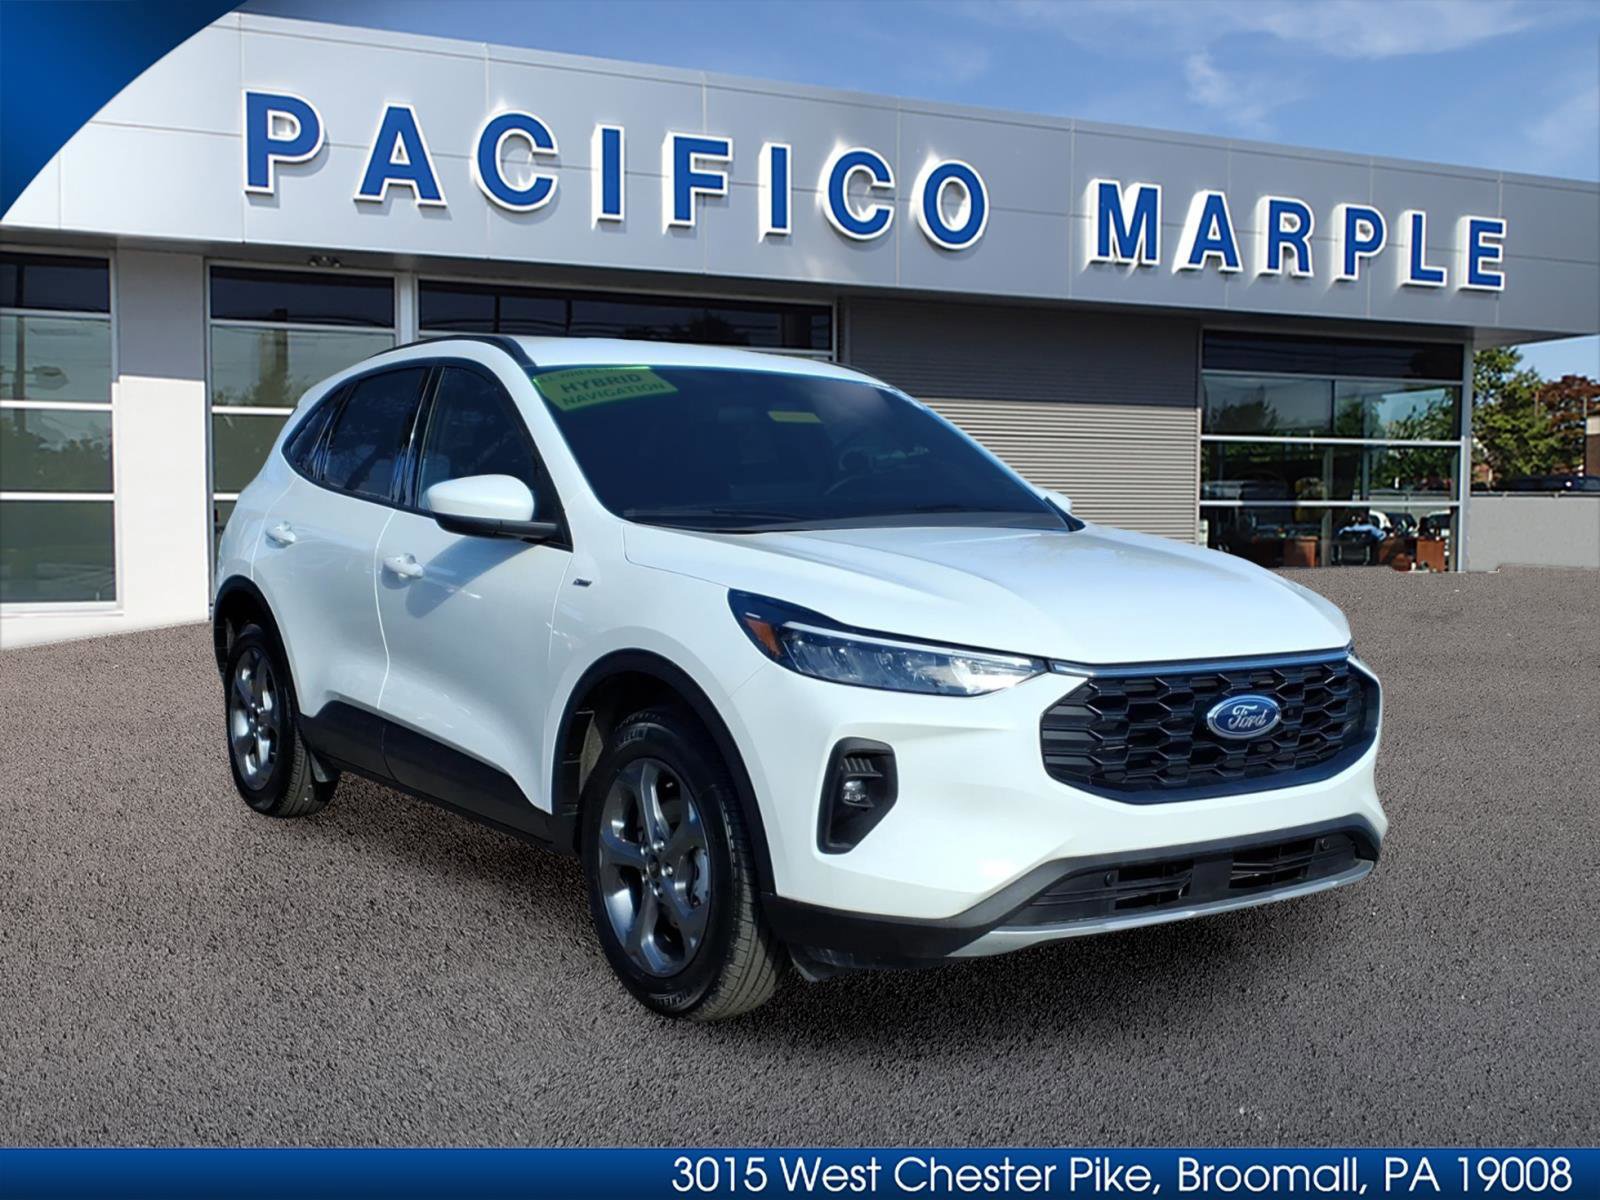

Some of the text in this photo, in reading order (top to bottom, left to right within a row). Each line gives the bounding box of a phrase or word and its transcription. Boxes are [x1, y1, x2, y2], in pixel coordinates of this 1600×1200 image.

[242, 88, 1507, 292] PACIFICO MARPLE
[561, 373, 643, 394] HYBRID
[562, 382, 666, 406] NAVIGATION
[1228, 704, 1268, 730] Ford
